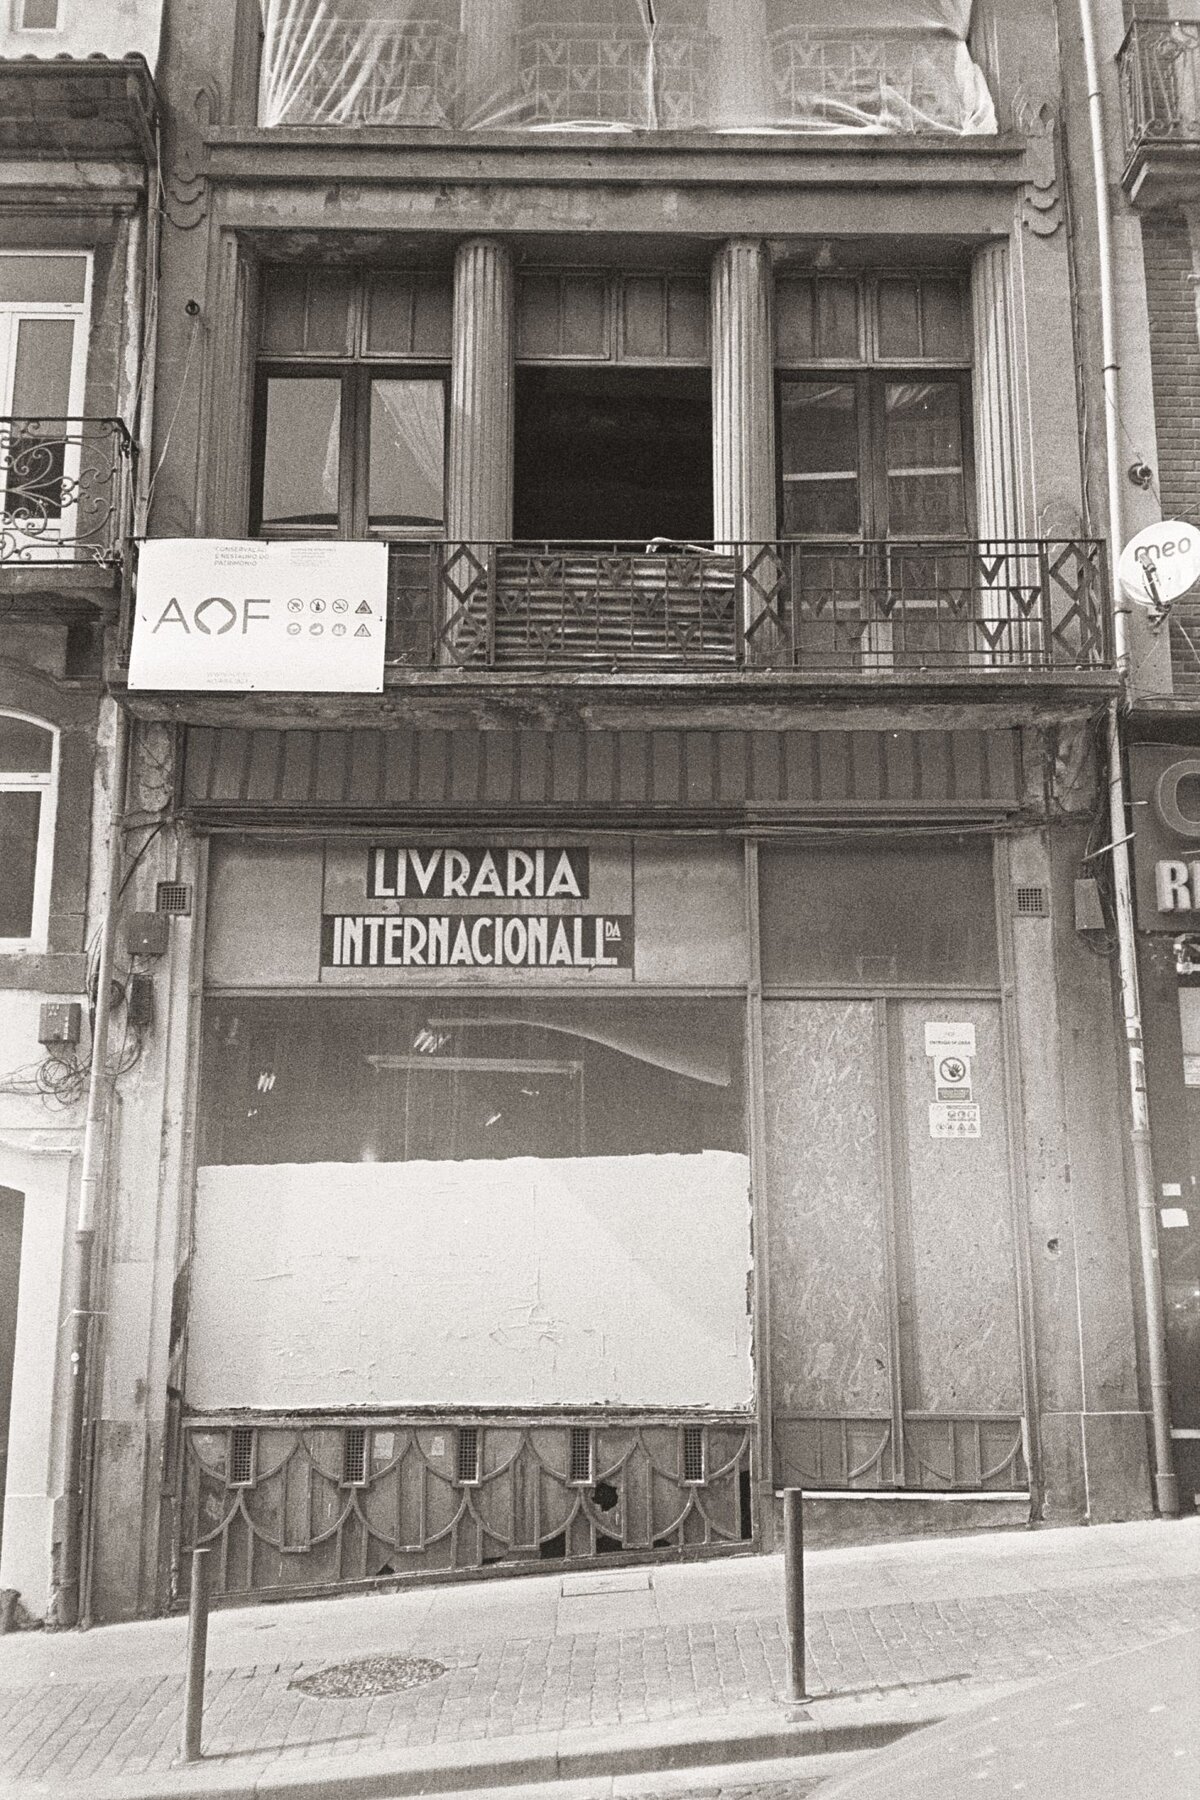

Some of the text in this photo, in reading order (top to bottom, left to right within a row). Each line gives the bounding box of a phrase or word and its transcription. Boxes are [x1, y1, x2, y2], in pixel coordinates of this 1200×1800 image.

[1134, 537, 1192, 562] meo
[151, 597, 271, 635] AOF
[374, 848, 582, 898] LIVRARIA
